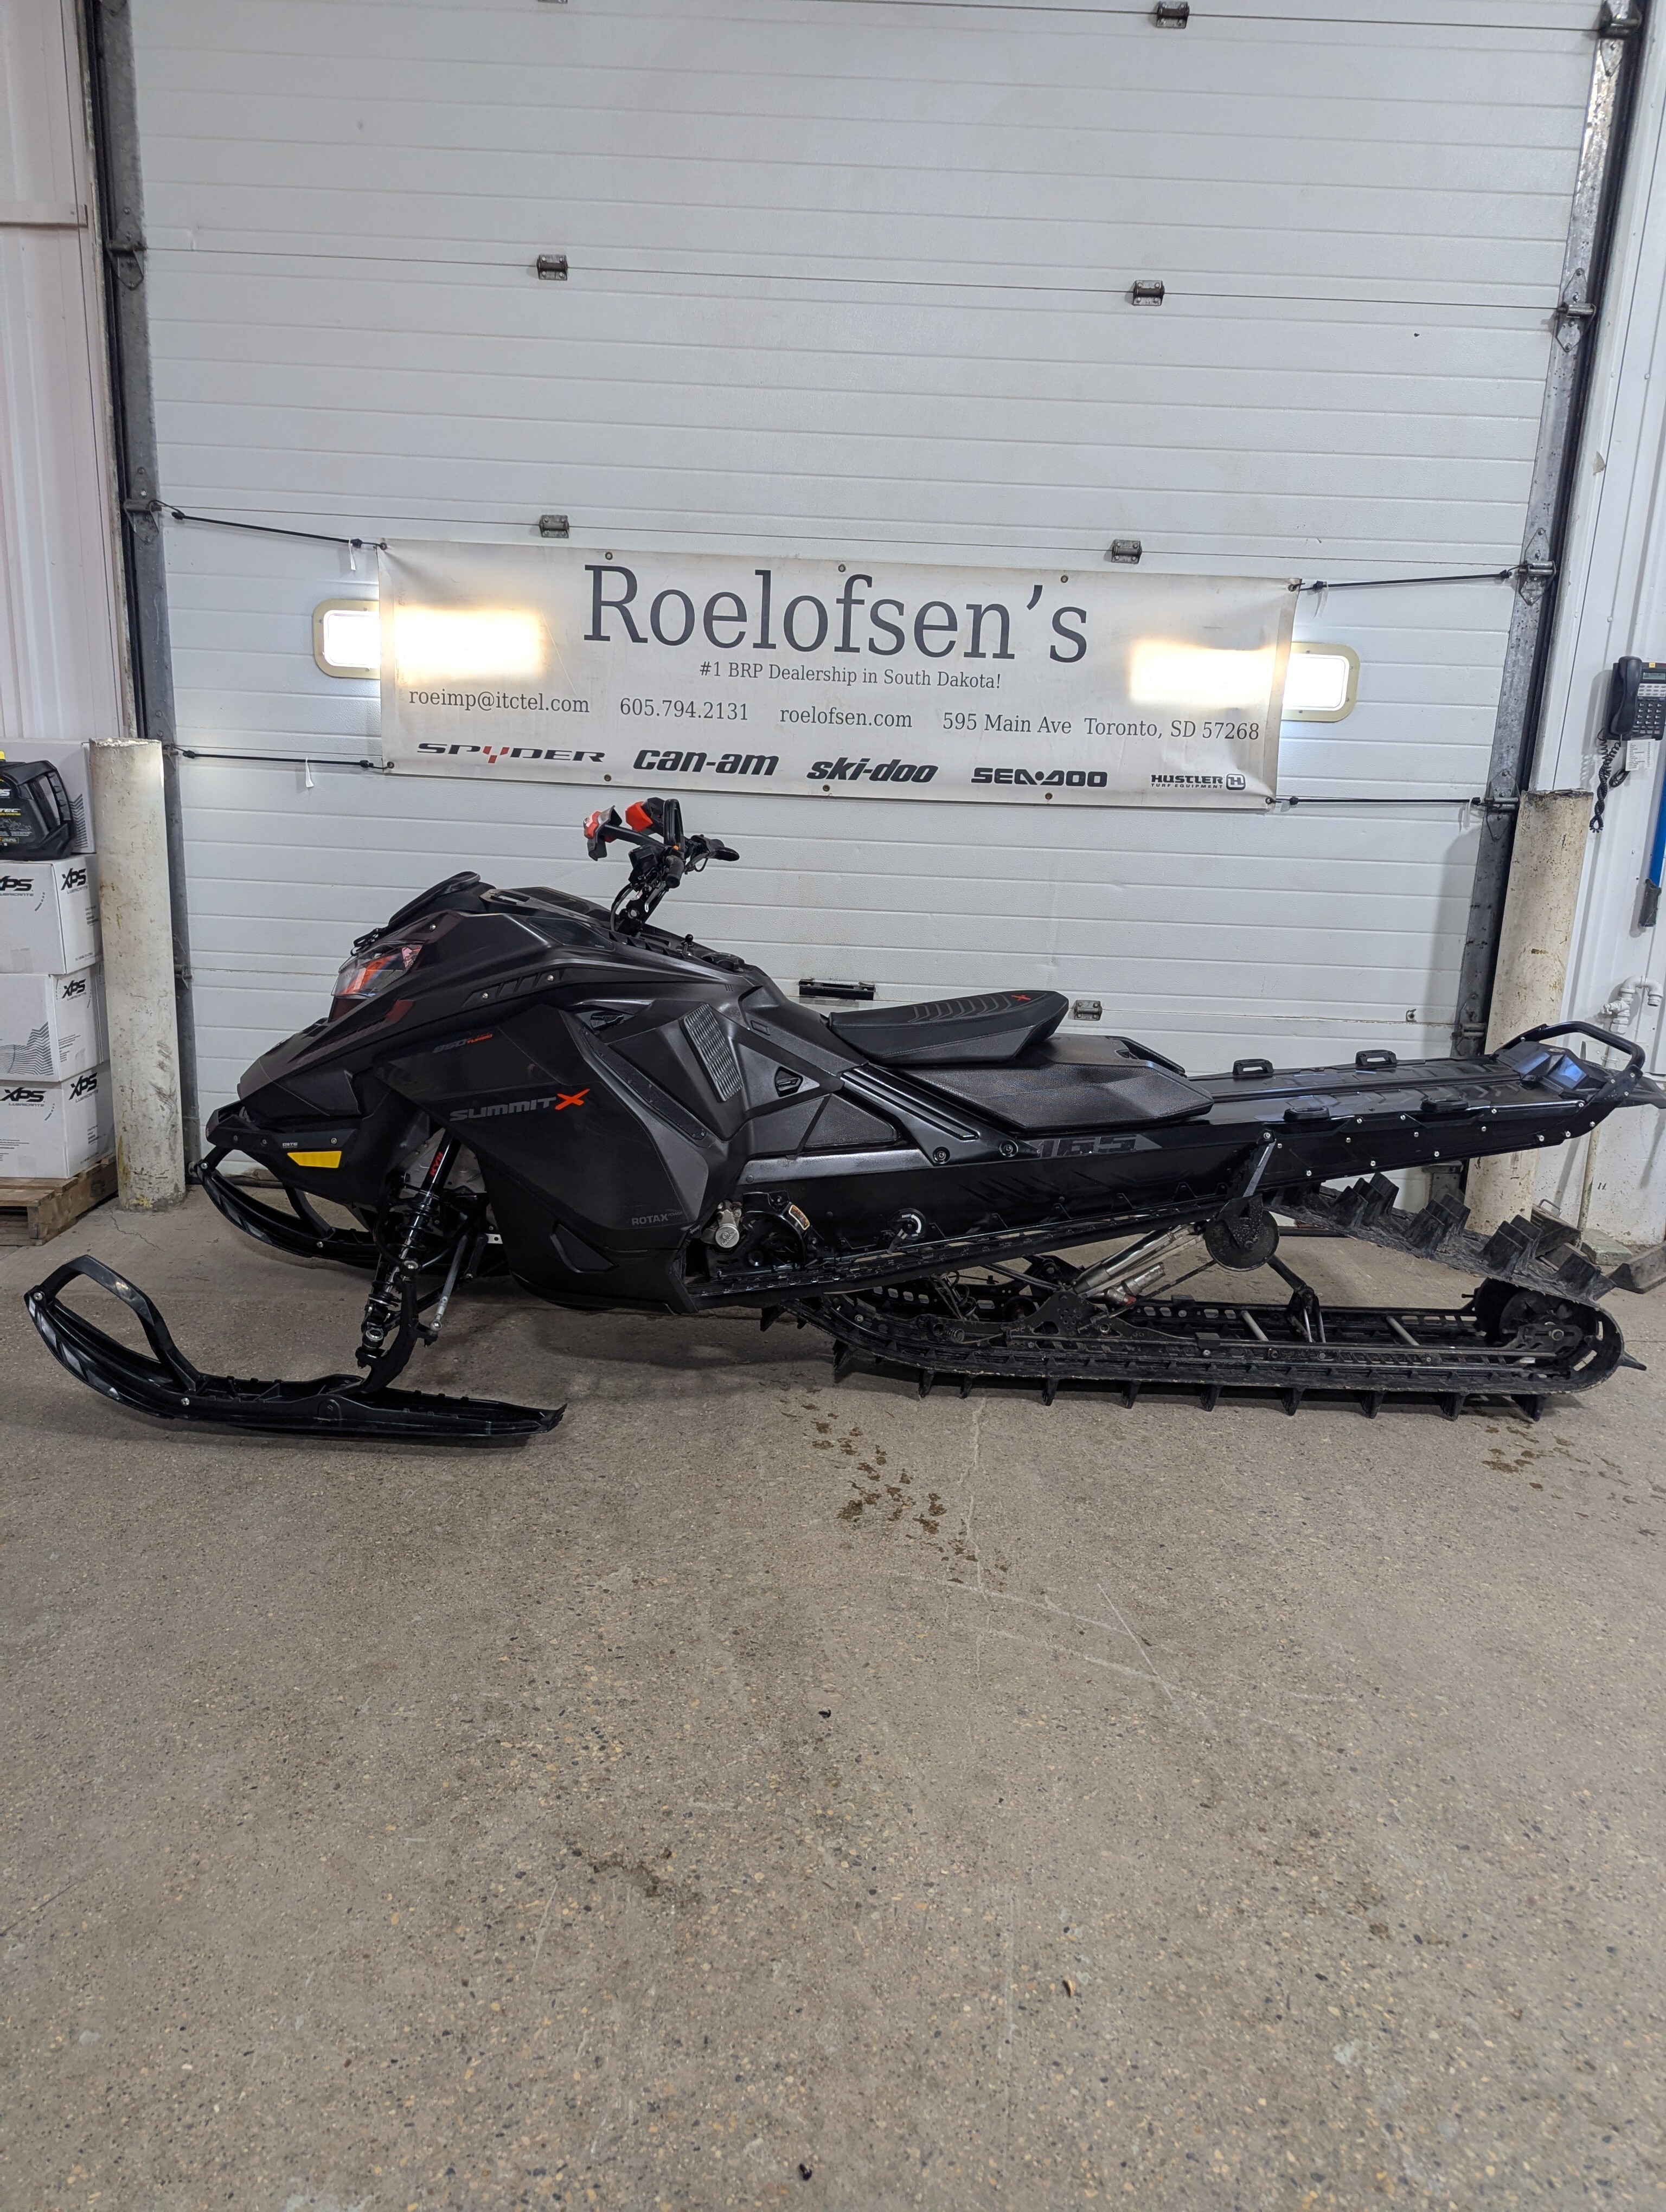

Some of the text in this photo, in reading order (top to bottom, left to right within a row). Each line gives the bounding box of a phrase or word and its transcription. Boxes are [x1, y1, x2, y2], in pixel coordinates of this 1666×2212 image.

[699, 661, 1001, 689] #1 BRP Dealership in South Dakota!
[409, 689, 1259, 740] roeimp@itctel.com 605.794.2131 roelofsen.com 595 Main Ave Toronto, SD 57268
[417, 743, 605, 763] SPYDER
[806, 757, 939, 781] ski-doo
[1151, 774, 1223, 784] HUSTLER
[61, 868, 87, 891] XPS
[62, 979, 86, 999] XPS
[0, 1087, 47, 1103] XPS
[69, 1072, 98, 1101] XPS
[450, 1088, 591, 1121] SUMMIT X
[631, 1213, 669, 1225] ROTAX
